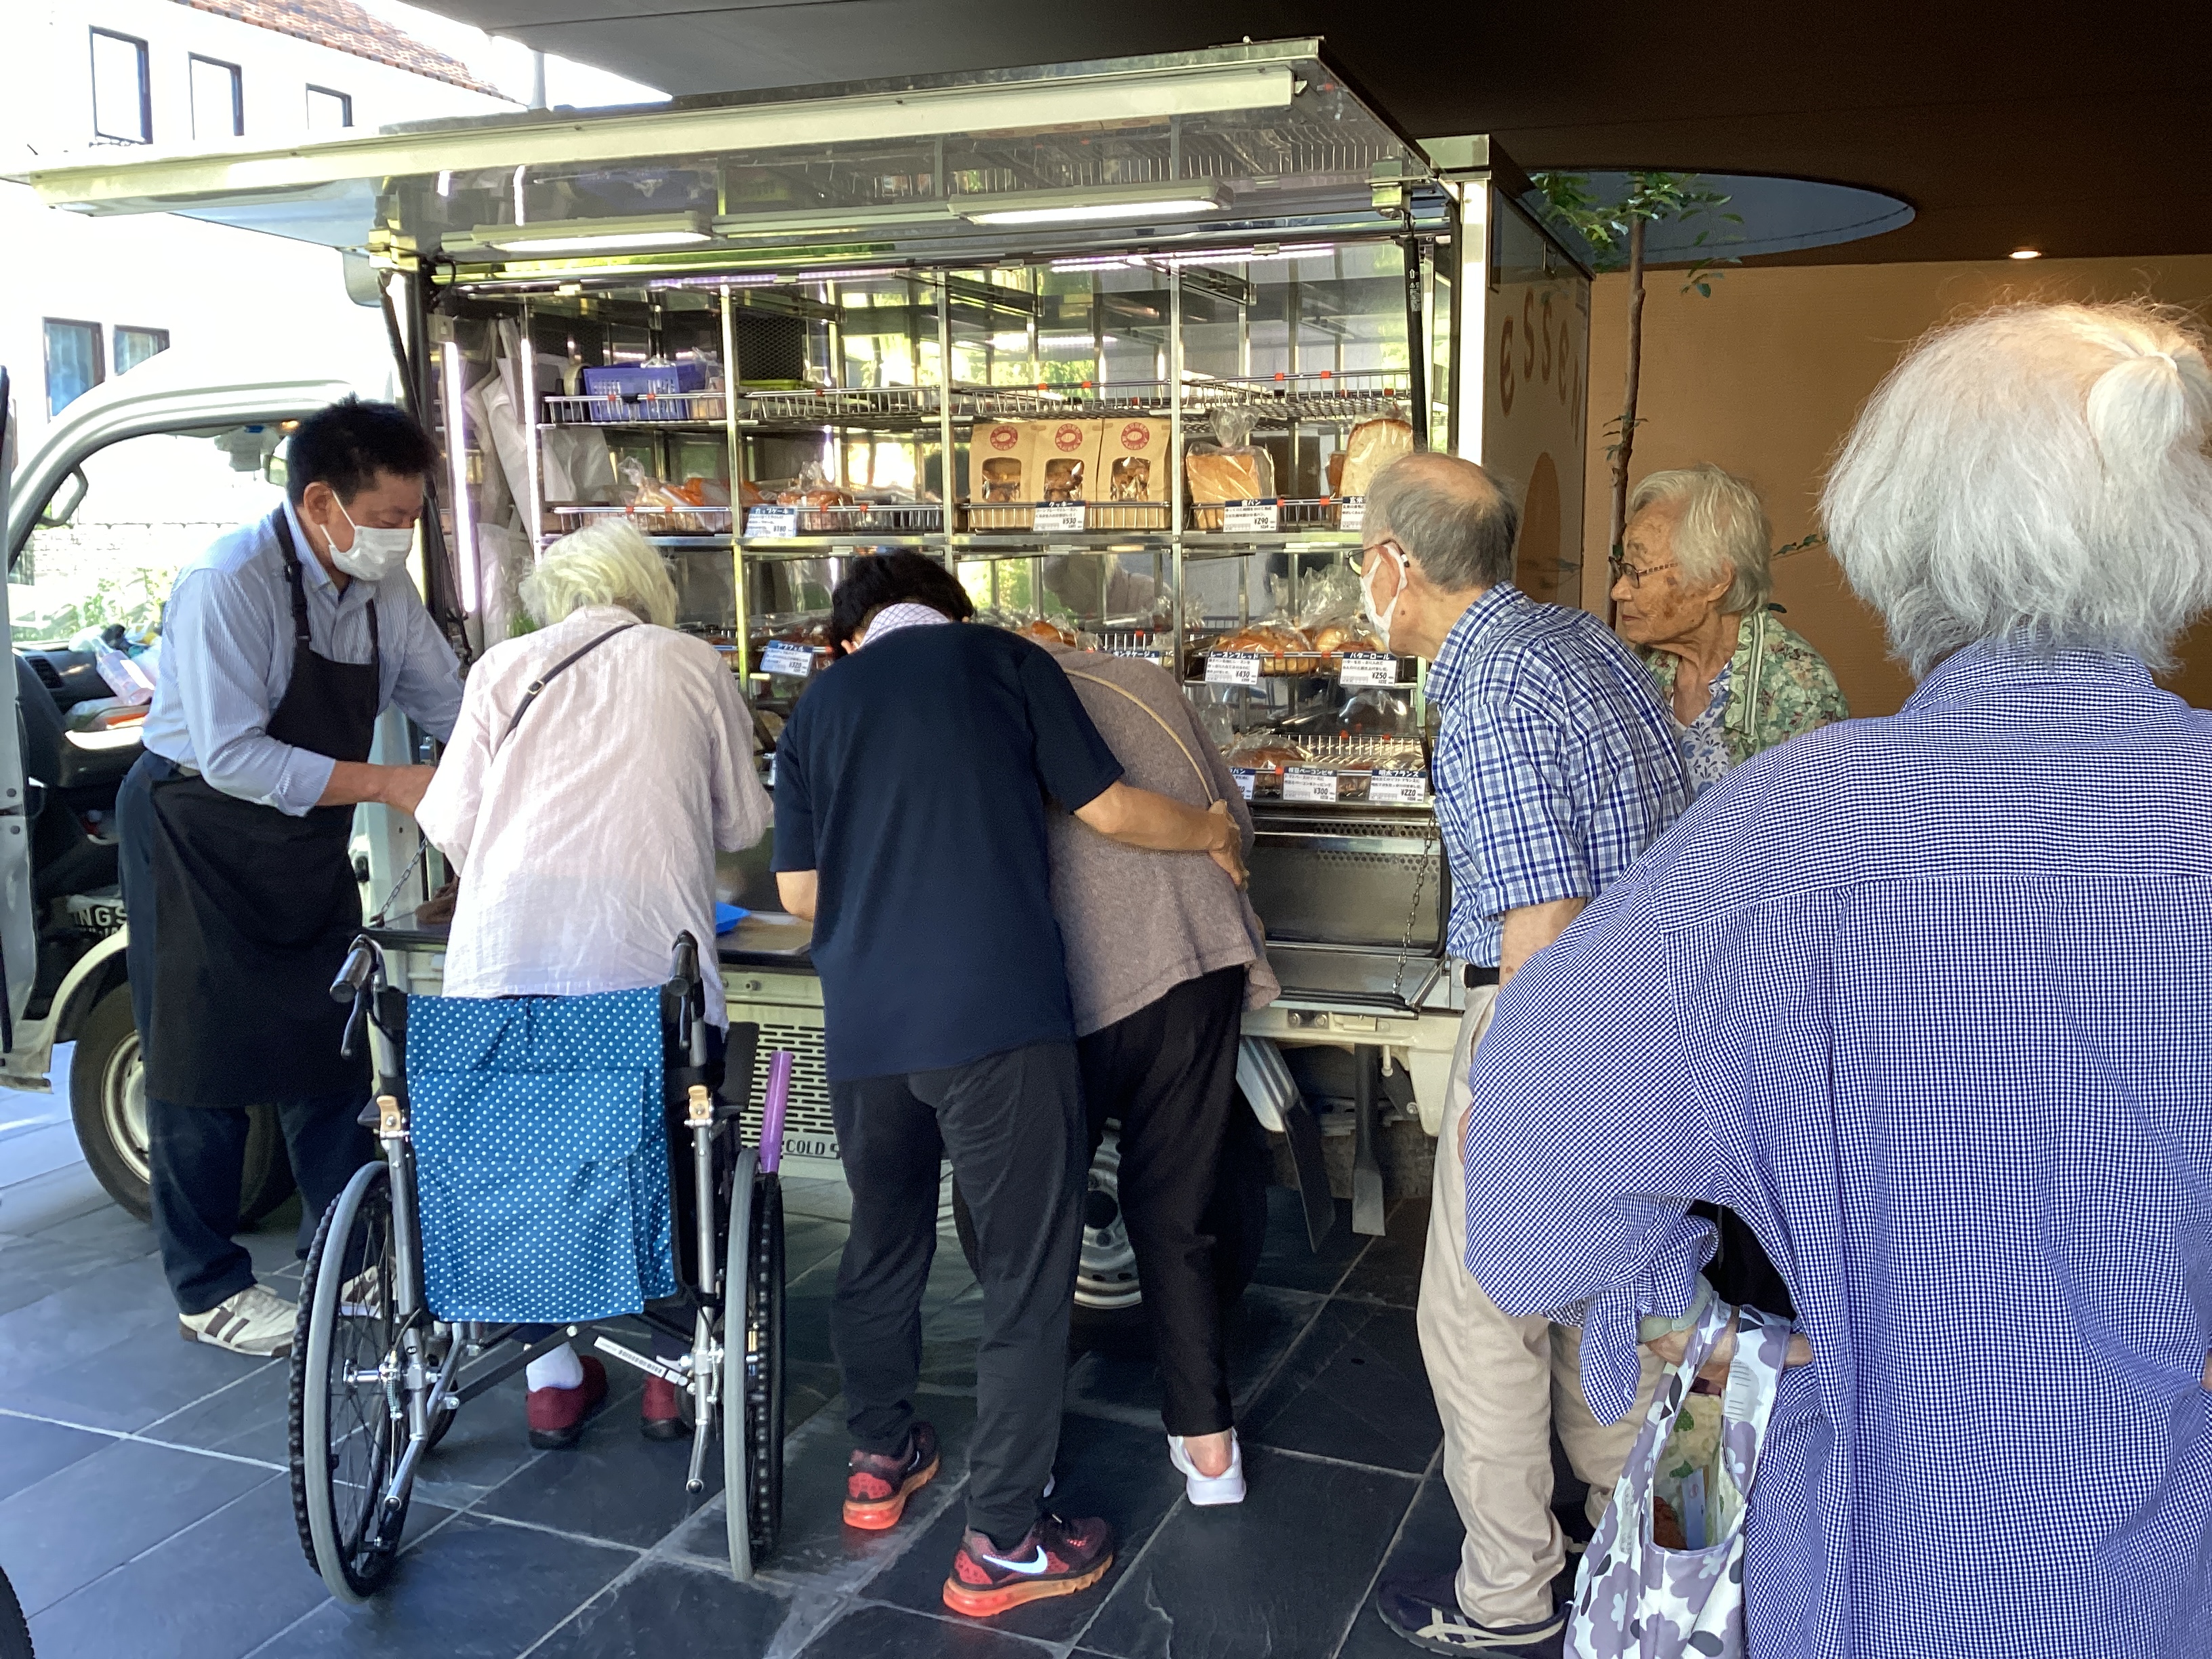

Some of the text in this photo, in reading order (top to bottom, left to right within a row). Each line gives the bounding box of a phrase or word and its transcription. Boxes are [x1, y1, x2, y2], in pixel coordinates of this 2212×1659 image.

[1241, 499, 1261, 507] 食パン
[1350, 652, 1390, 660] バターロール
[1313, 787, 1328, 795] ¥300
[785, 1139, 825, 1155] COLD
